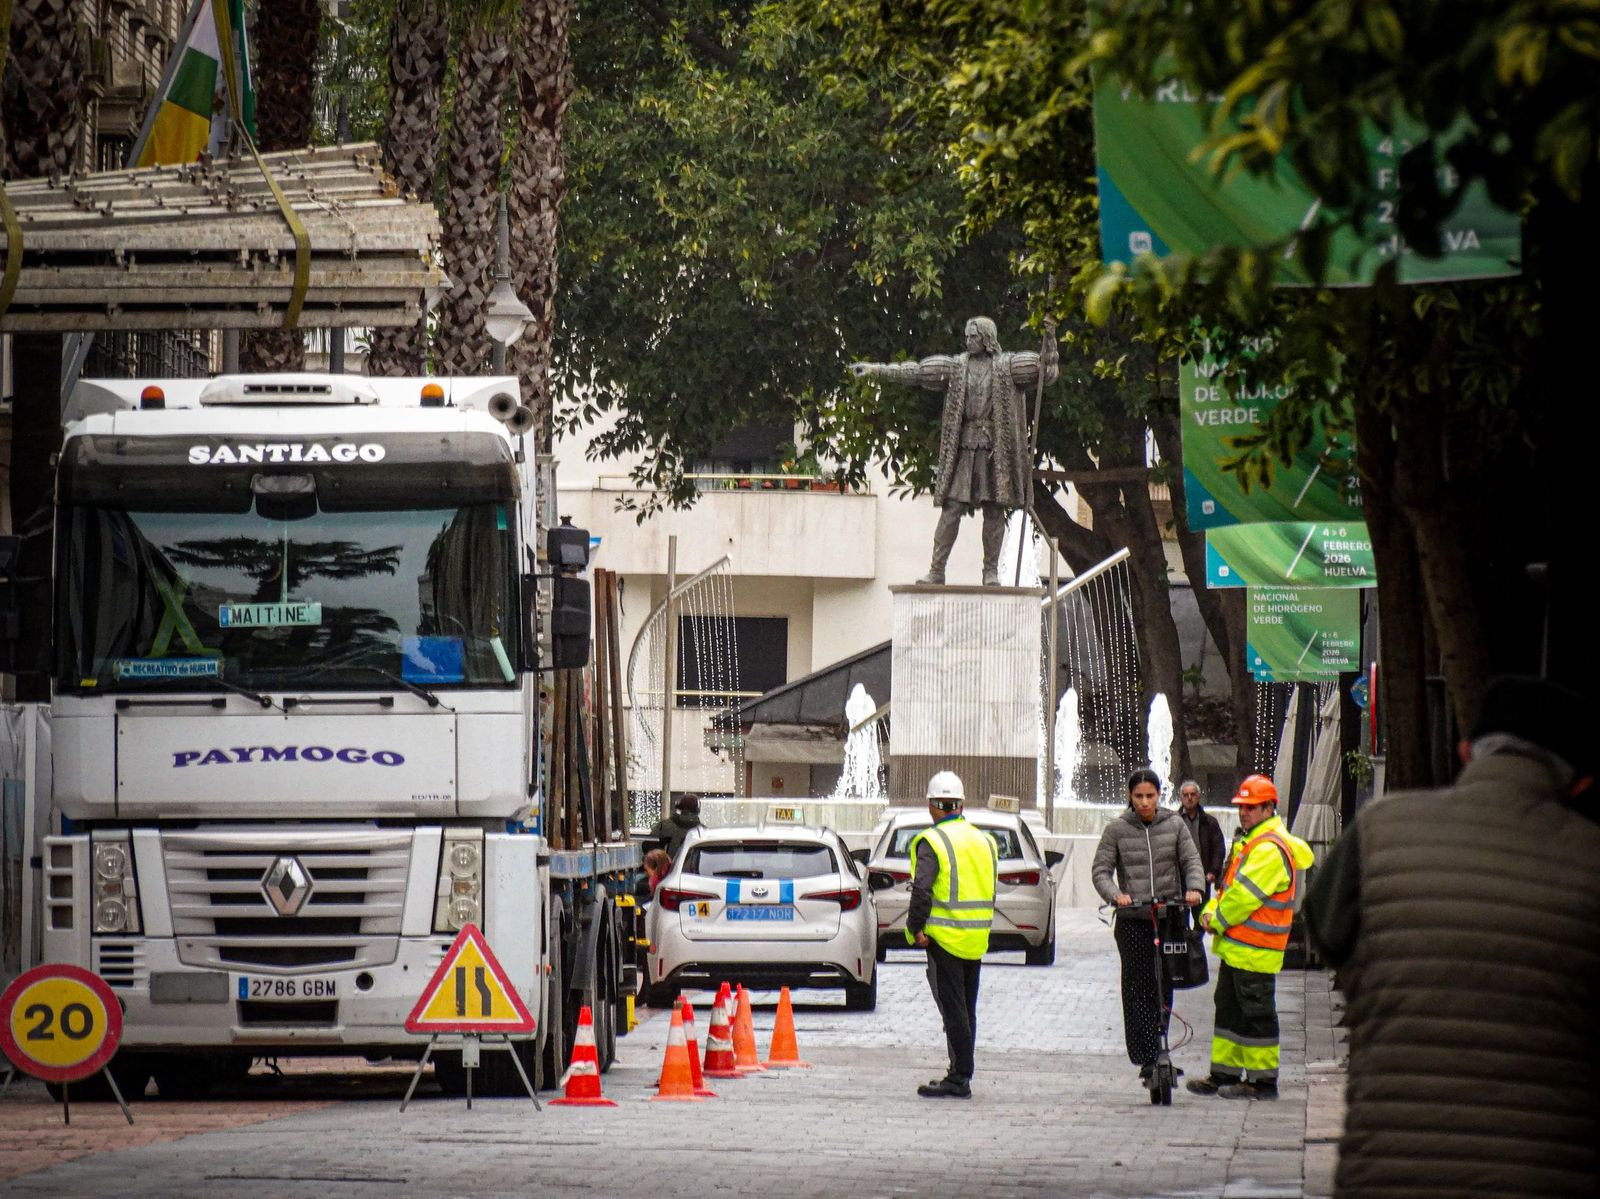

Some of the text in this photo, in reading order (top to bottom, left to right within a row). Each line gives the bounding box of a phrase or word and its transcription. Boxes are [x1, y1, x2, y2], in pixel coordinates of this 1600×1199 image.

[1194, 386, 1220, 402] DE
[1195, 408, 1260, 426] VERDE
[188, 443, 386, 464] SANTIAGO
[1323, 541, 1373, 552] FEBRERO
[1324, 554, 1352, 564] 2026
[1325, 567, 1367, 577] HUELVA
[1253, 593, 1300, 602] NACIONAL
[1253, 604, 1266, 613] DE
[1253, 616, 1284, 625] VERDE
[172, 746, 405, 768] PAYMOGO
[699, 903, 710, 917] 4
[251, 980, 337, 997] 2786 GBM
[24, 1002, 94, 1041] 20
